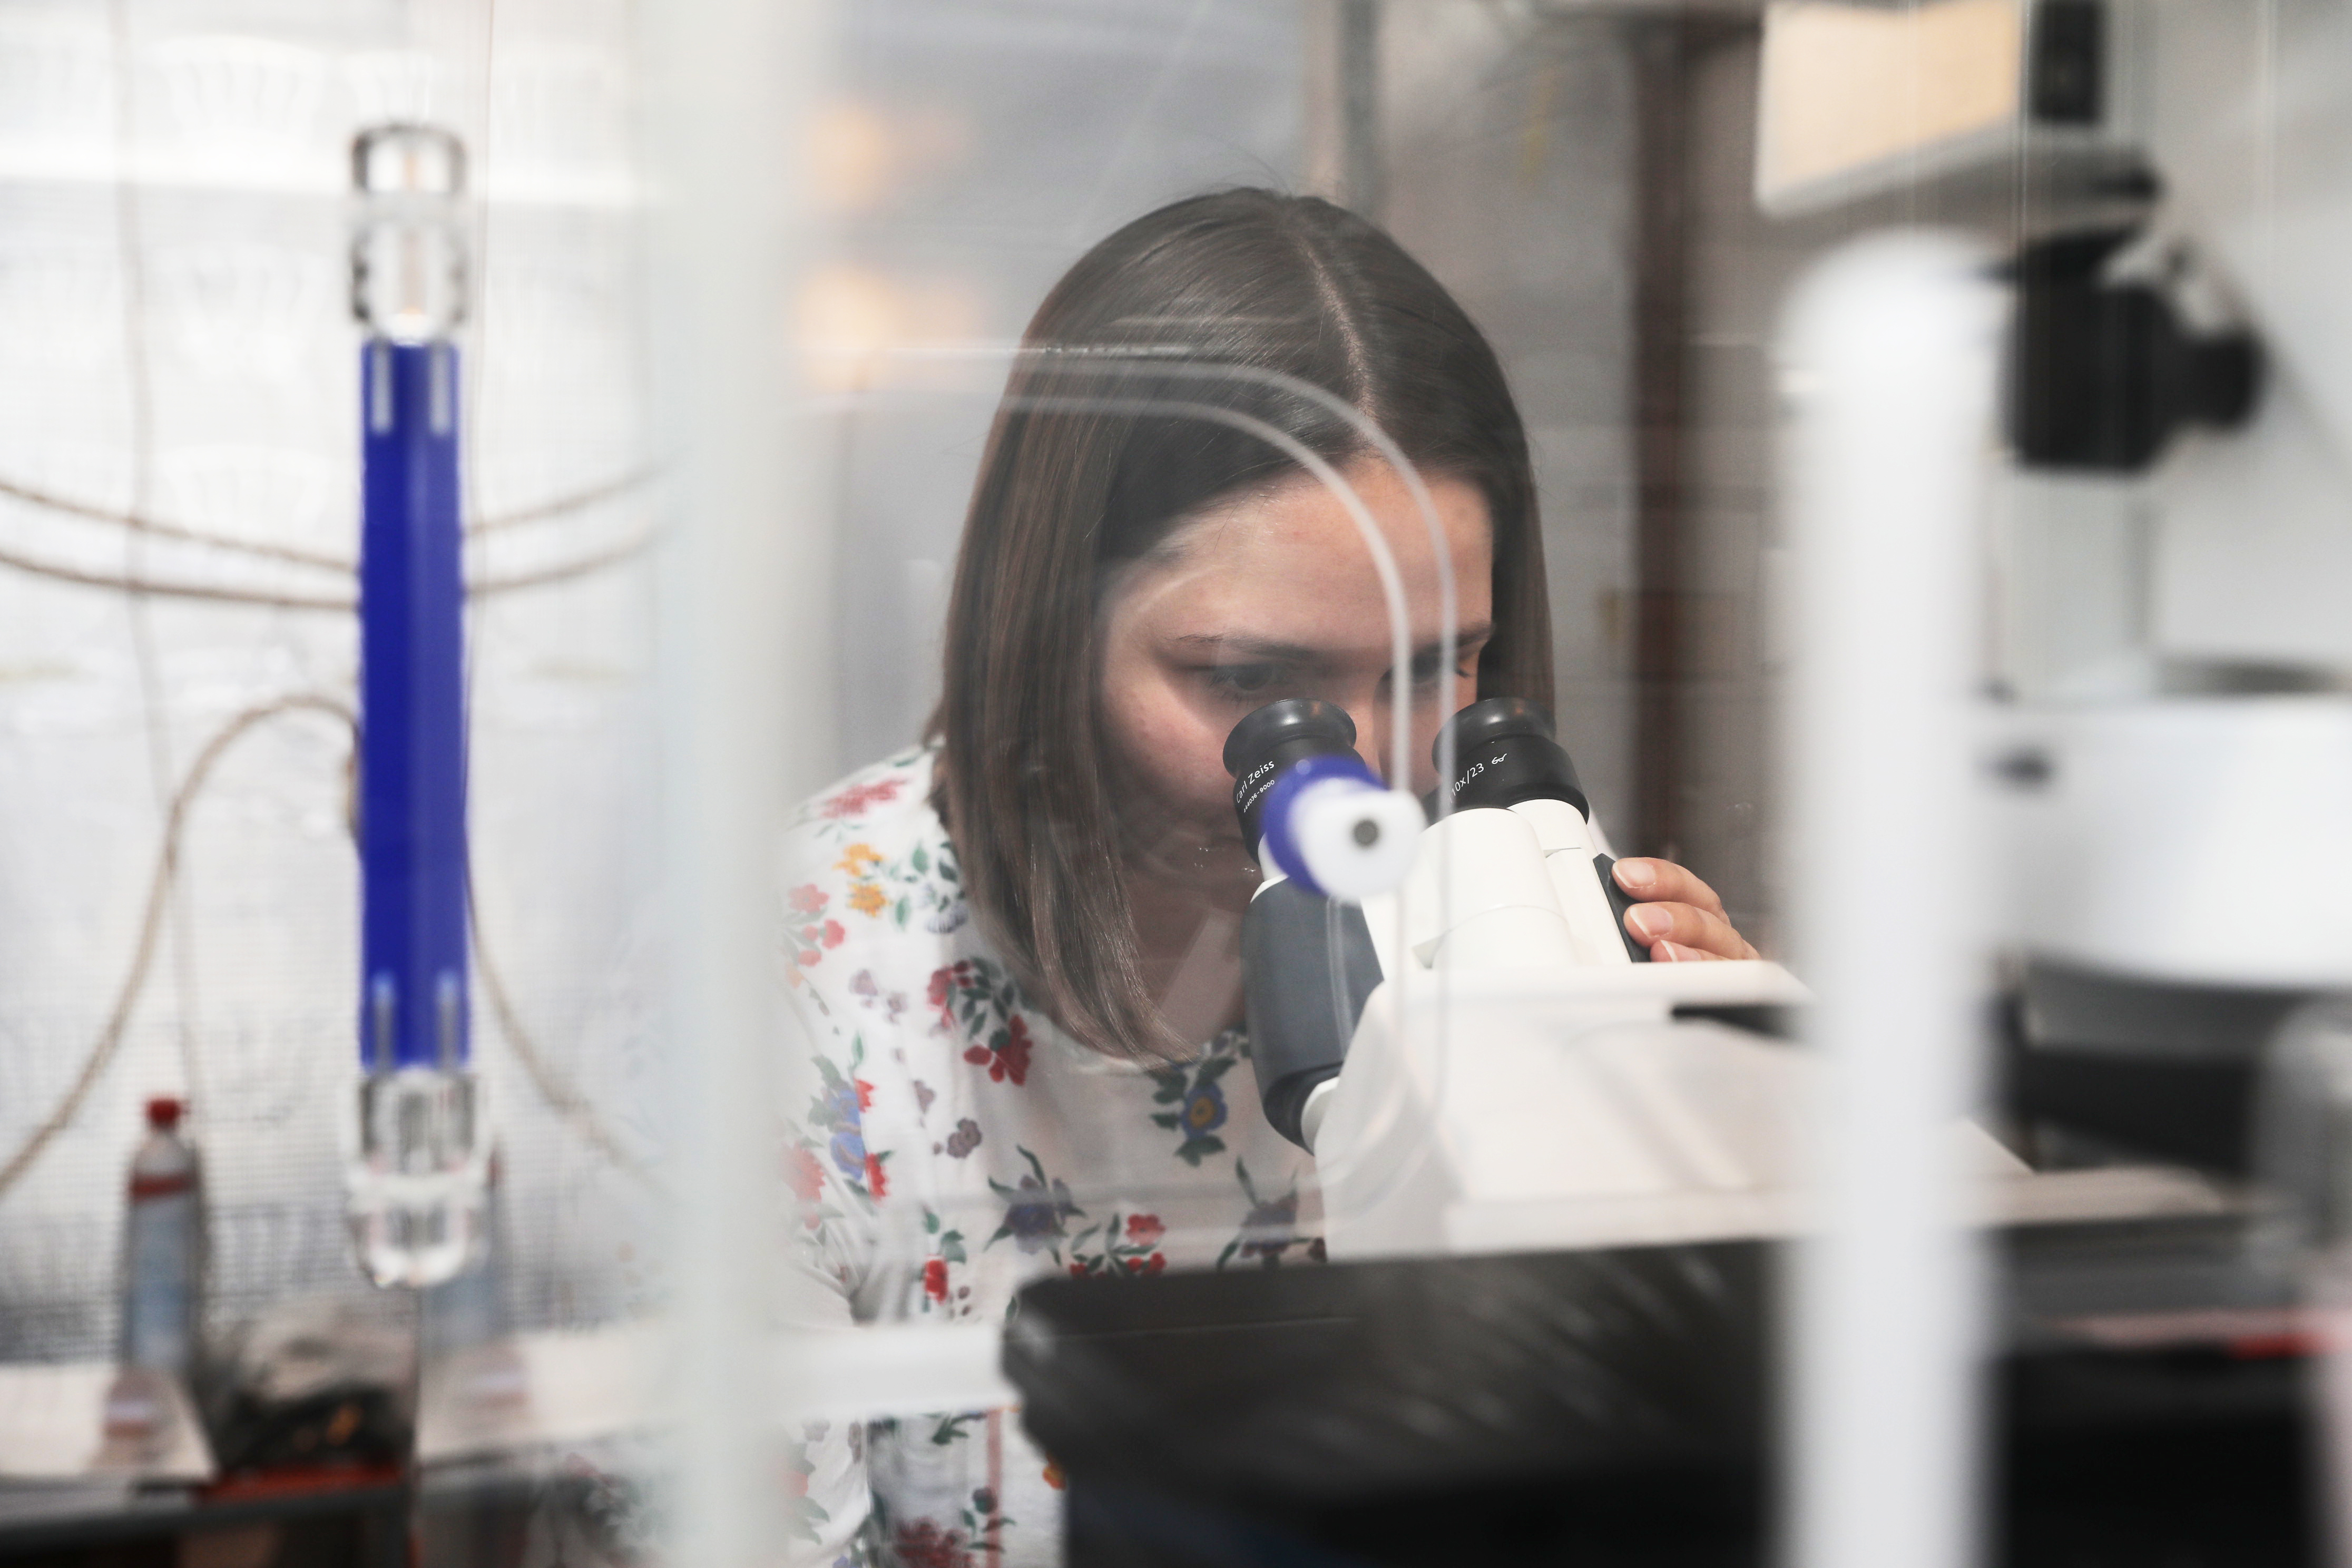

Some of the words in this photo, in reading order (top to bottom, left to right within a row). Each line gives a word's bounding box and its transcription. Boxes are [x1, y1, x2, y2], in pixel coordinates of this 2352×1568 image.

[1237, 780, 1248, 803] Carl
[1248, 761, 1275, 785] Zeiss
[1452, 763, 1484, 797] 10x/23
